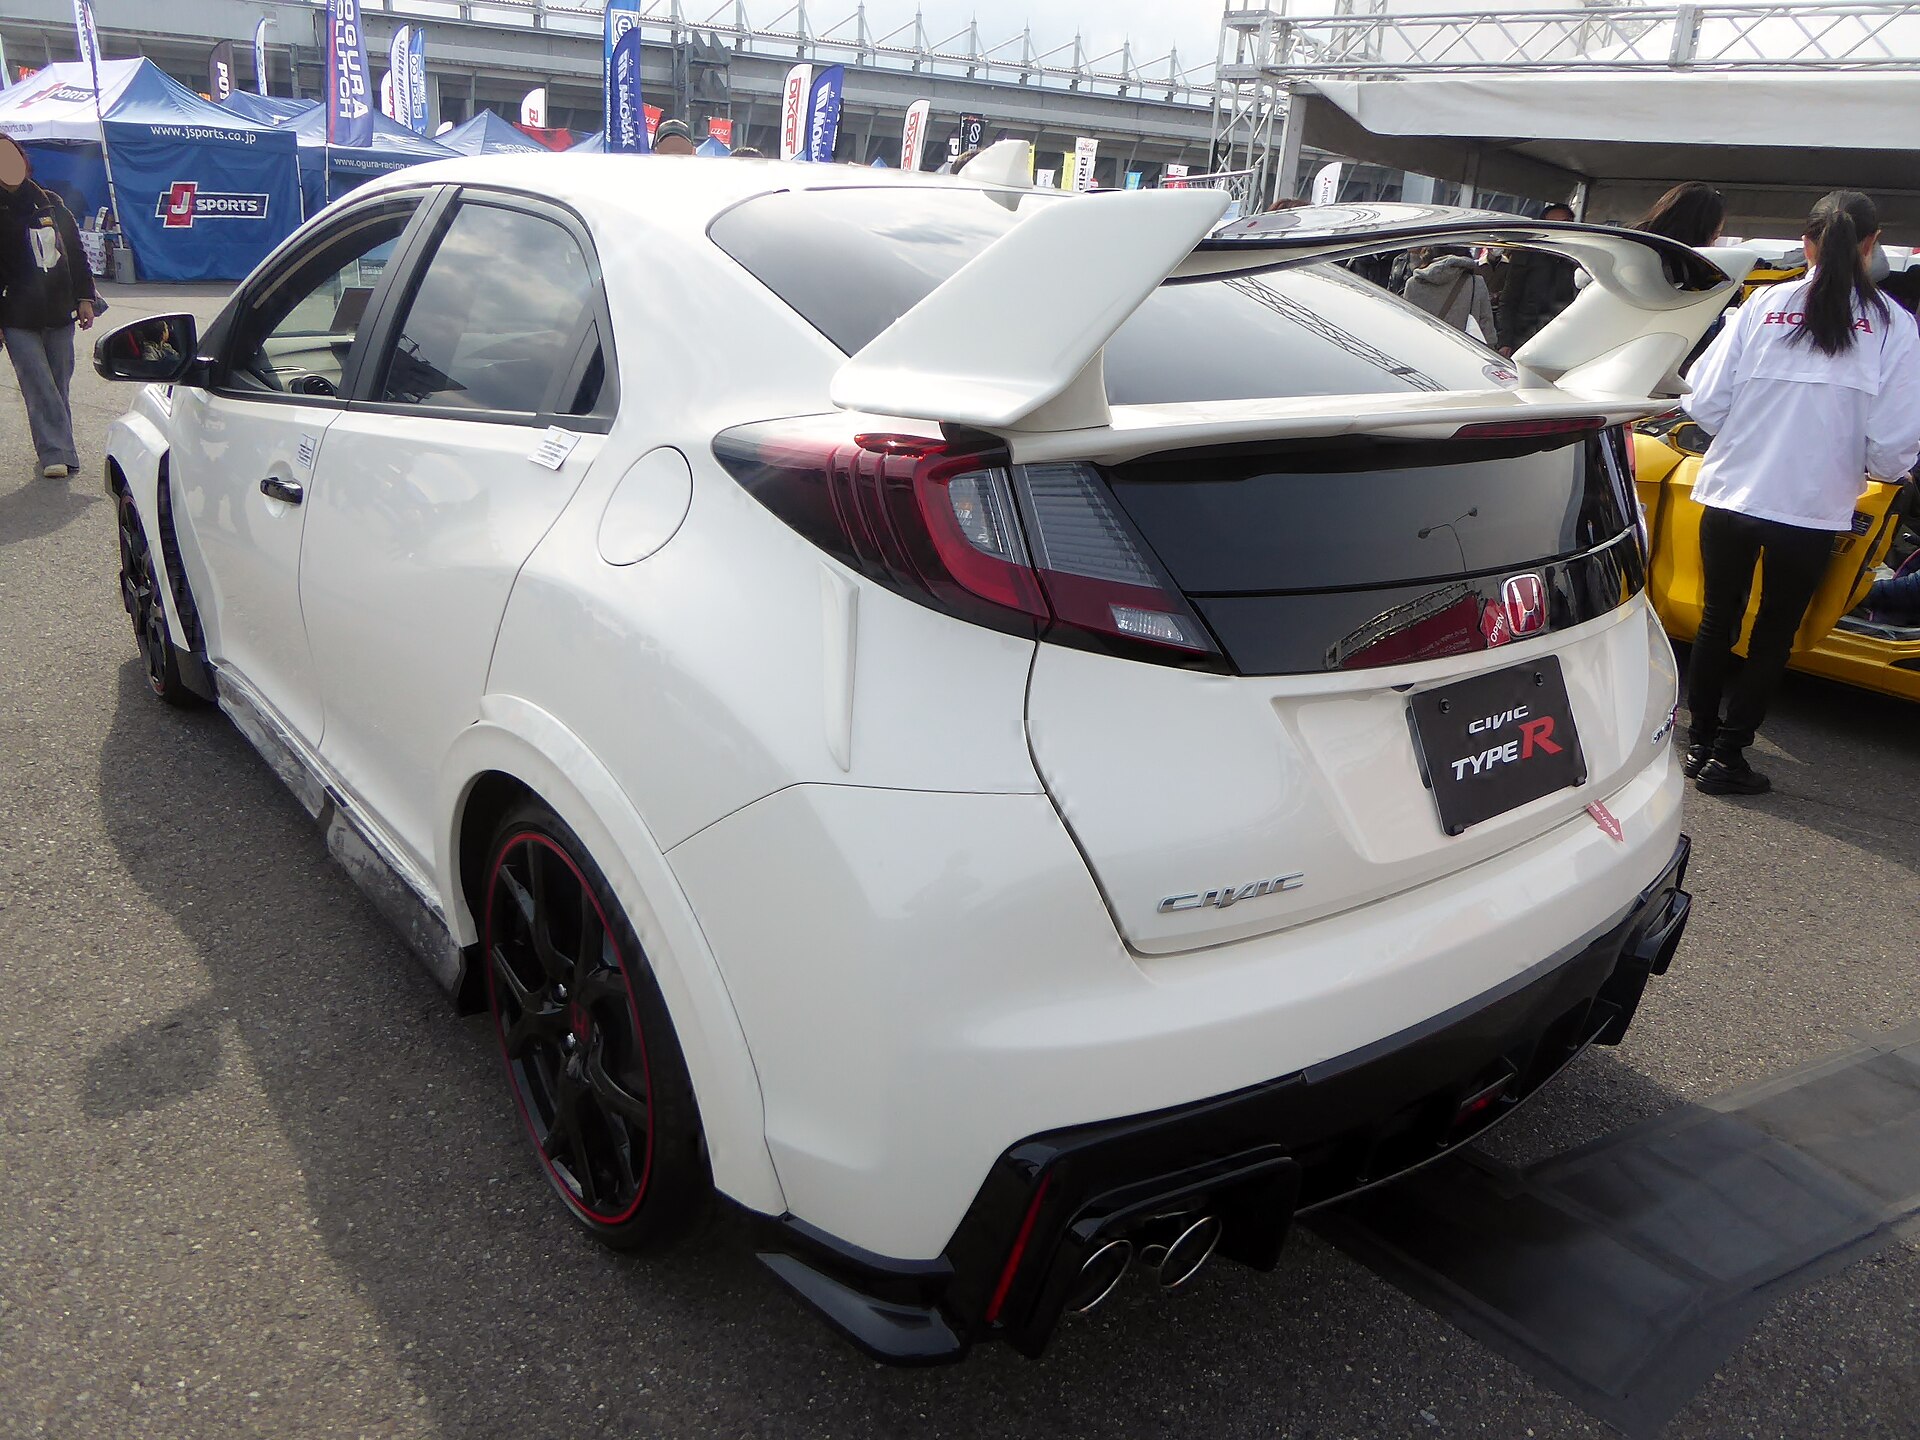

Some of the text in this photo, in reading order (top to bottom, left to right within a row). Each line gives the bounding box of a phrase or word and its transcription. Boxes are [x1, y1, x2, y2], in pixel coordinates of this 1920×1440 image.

[150, 125, 257, 145] www.jsports.co.jp
[170, 191, 258, 215] J SPORTS
[1763, 311, 1874, 334] HOA
[1490, 612, 1505, 643] OPEN
[1468, 705, 1529, 735] CIVIC
[1451, 716, 1564, 781] TYPE R
[1156, 871, 1304, 914] CIVIC
